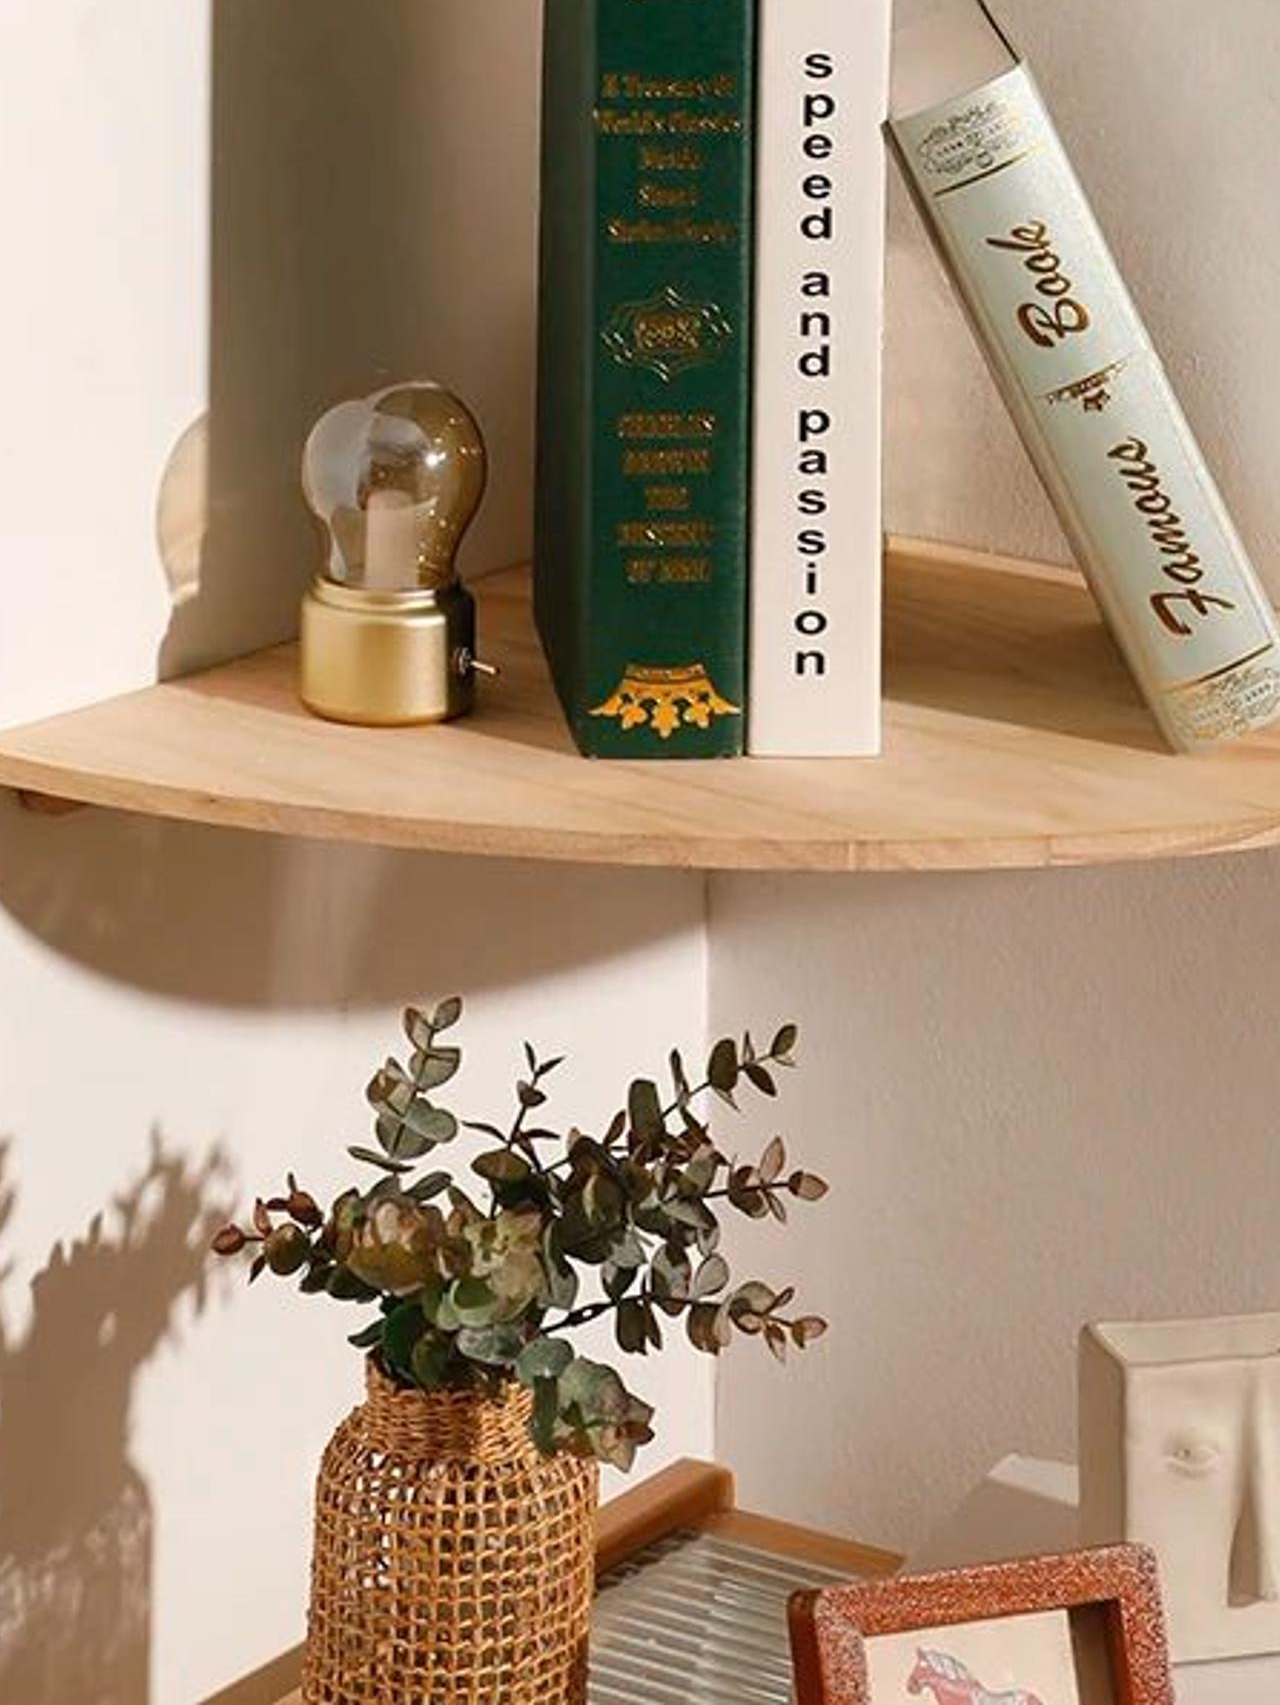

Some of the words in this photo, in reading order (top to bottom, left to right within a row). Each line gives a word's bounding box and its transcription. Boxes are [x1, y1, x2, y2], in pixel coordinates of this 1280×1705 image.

[800, 53, 835, 240] speed
[798, 271, 830, 377] and
[985, 220, 1090, 348] Book
[794, 409, 830, 675] passion
[1107, 436, 1235, 636] Famous
